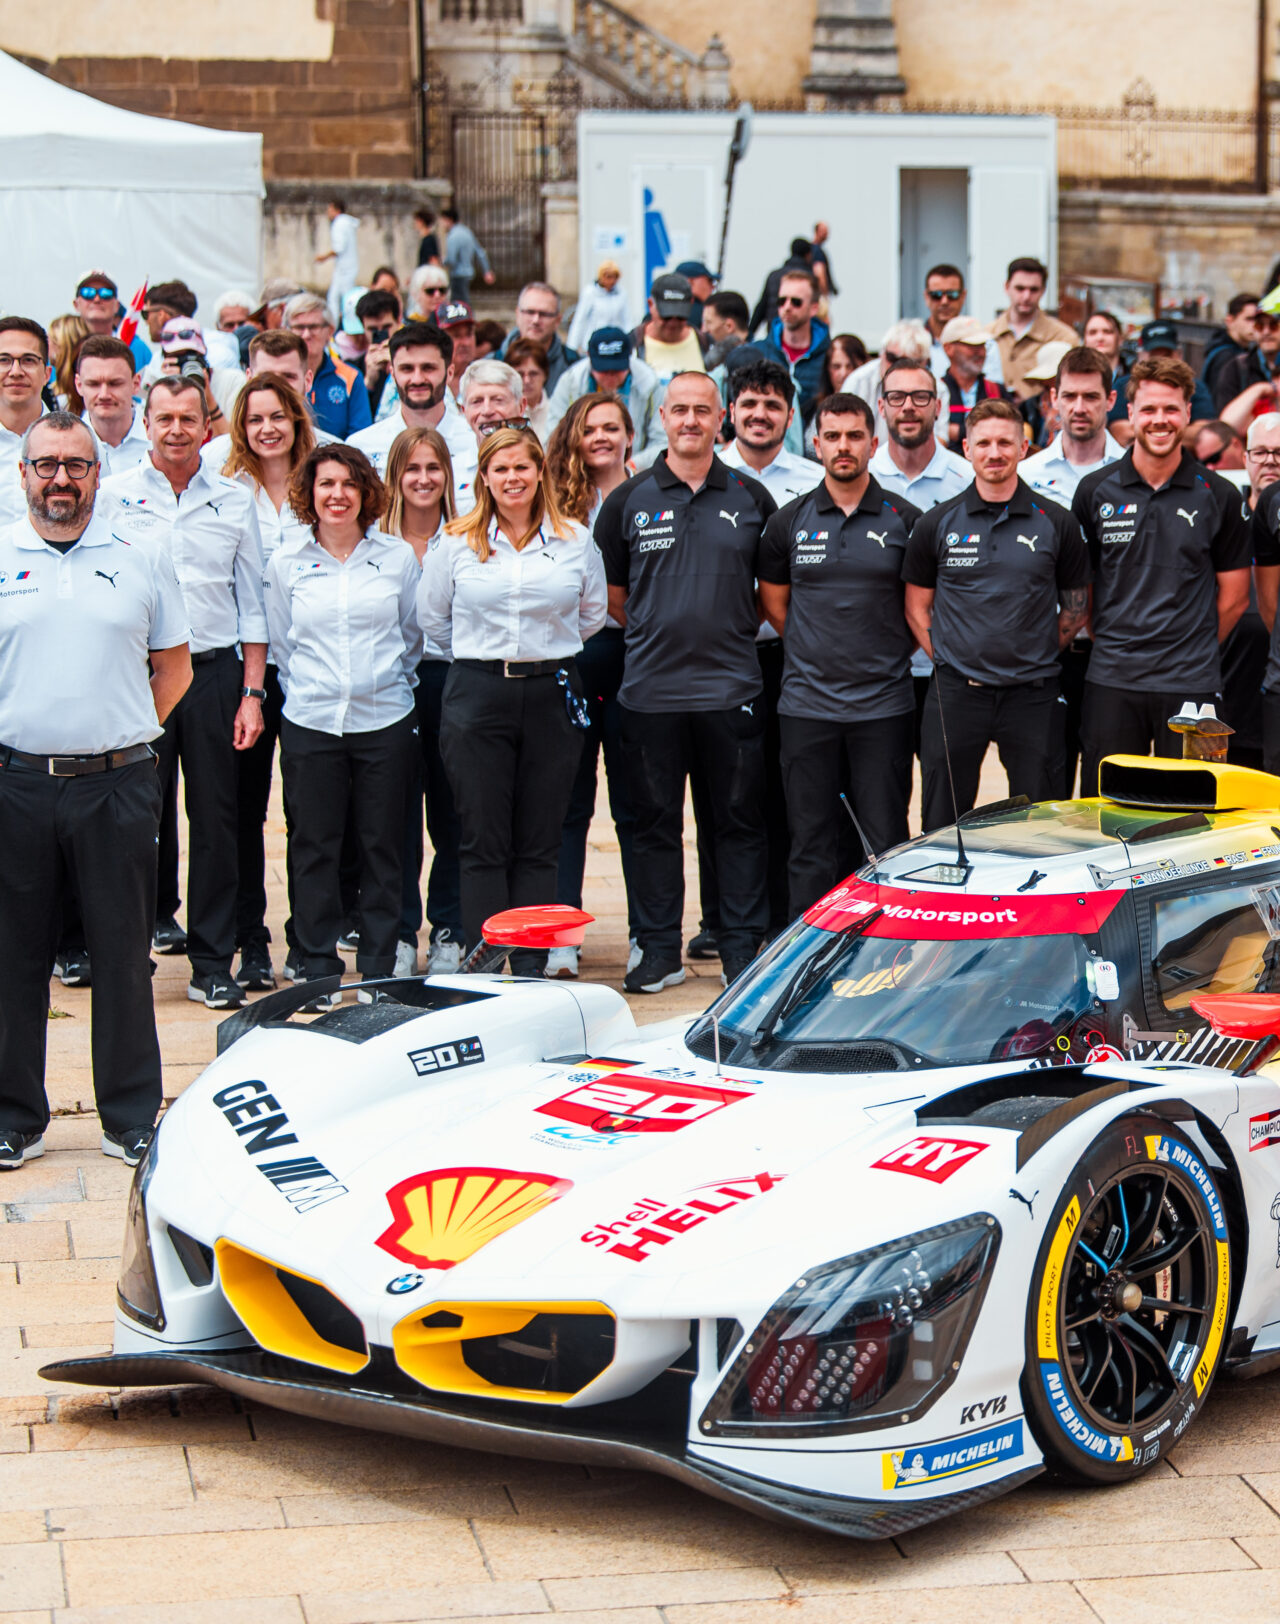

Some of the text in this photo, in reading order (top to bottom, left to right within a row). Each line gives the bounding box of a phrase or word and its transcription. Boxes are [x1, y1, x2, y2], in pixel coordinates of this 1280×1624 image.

[639, 526, 673, 536] Motorsport
[639, 538, 675, 552] WRT
[1144, 860, 1211, 883] VAN DER LINDE
[1224, 852, 1248, 865] RAST
[882, 903, 1018, 925] Motorsport
[410, 1046, 460, 1073] 20
[559, 1082, 728, 1120] 20
[212, 1079, 299, 1156] GEN
[900, 1139, 963, 1168] HY
[1125, 1135, 1142, 1157] FL
[1172, 1145, 1224, 1229] MICHELIN
[580, 1198, 669, 1247] Shell
[604, 1171, 789, 1263] HELIX
[1065, 1206, 1077, 1232] M
[1044, 1262, 1058, 1348] PILOT SPORT
[1216, 1291, 1226, 1333] SPORT
[960, 1395, 1007, 1425] KYB
[1046, 1372, 1107, 1455] MICHELIN
[931, 1434, 1014, 1471] MICHELIN
